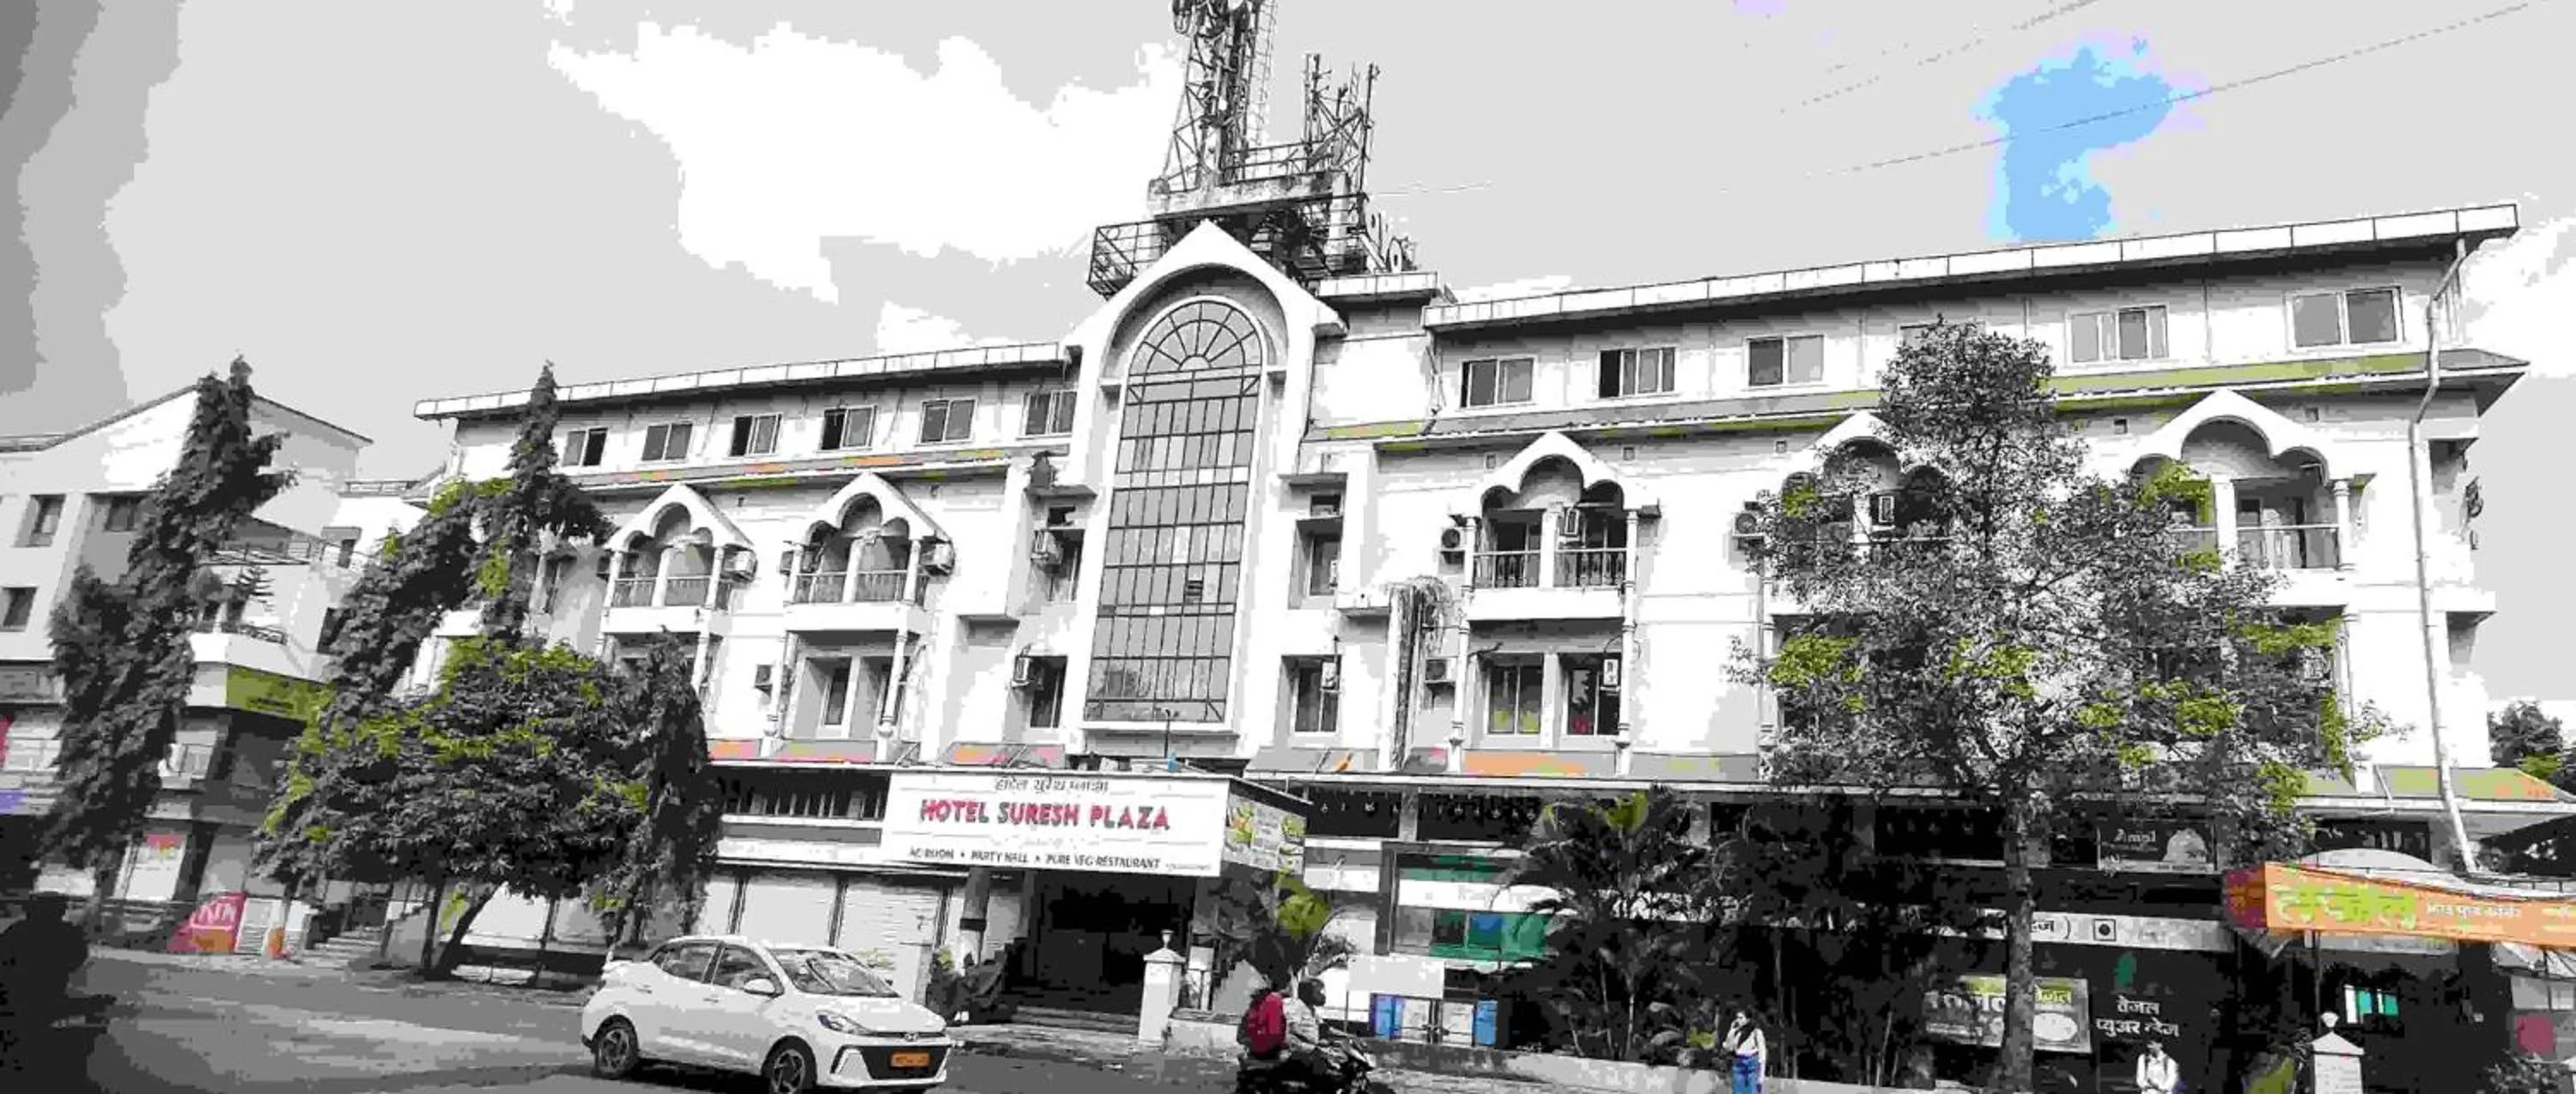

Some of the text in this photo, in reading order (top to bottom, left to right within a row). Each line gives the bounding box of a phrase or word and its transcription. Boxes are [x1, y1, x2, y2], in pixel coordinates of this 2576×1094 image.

[920, 799, 1170, 831] HOTEL SURESH PLAZA
[909, 847, 922, 858] AC
[924, 848, 954, 860] ROOM
[970, 850, 1003, 863] PARTY
[1004, 852, 1029, 864] HALL
[1045, 854, 1071, 866] PURE
[1074, 854, 1093, 866] VEG
[1095, 855, 1161, 870] RESTAURANT
[2116, 994, 2160, 1015] तेजल
